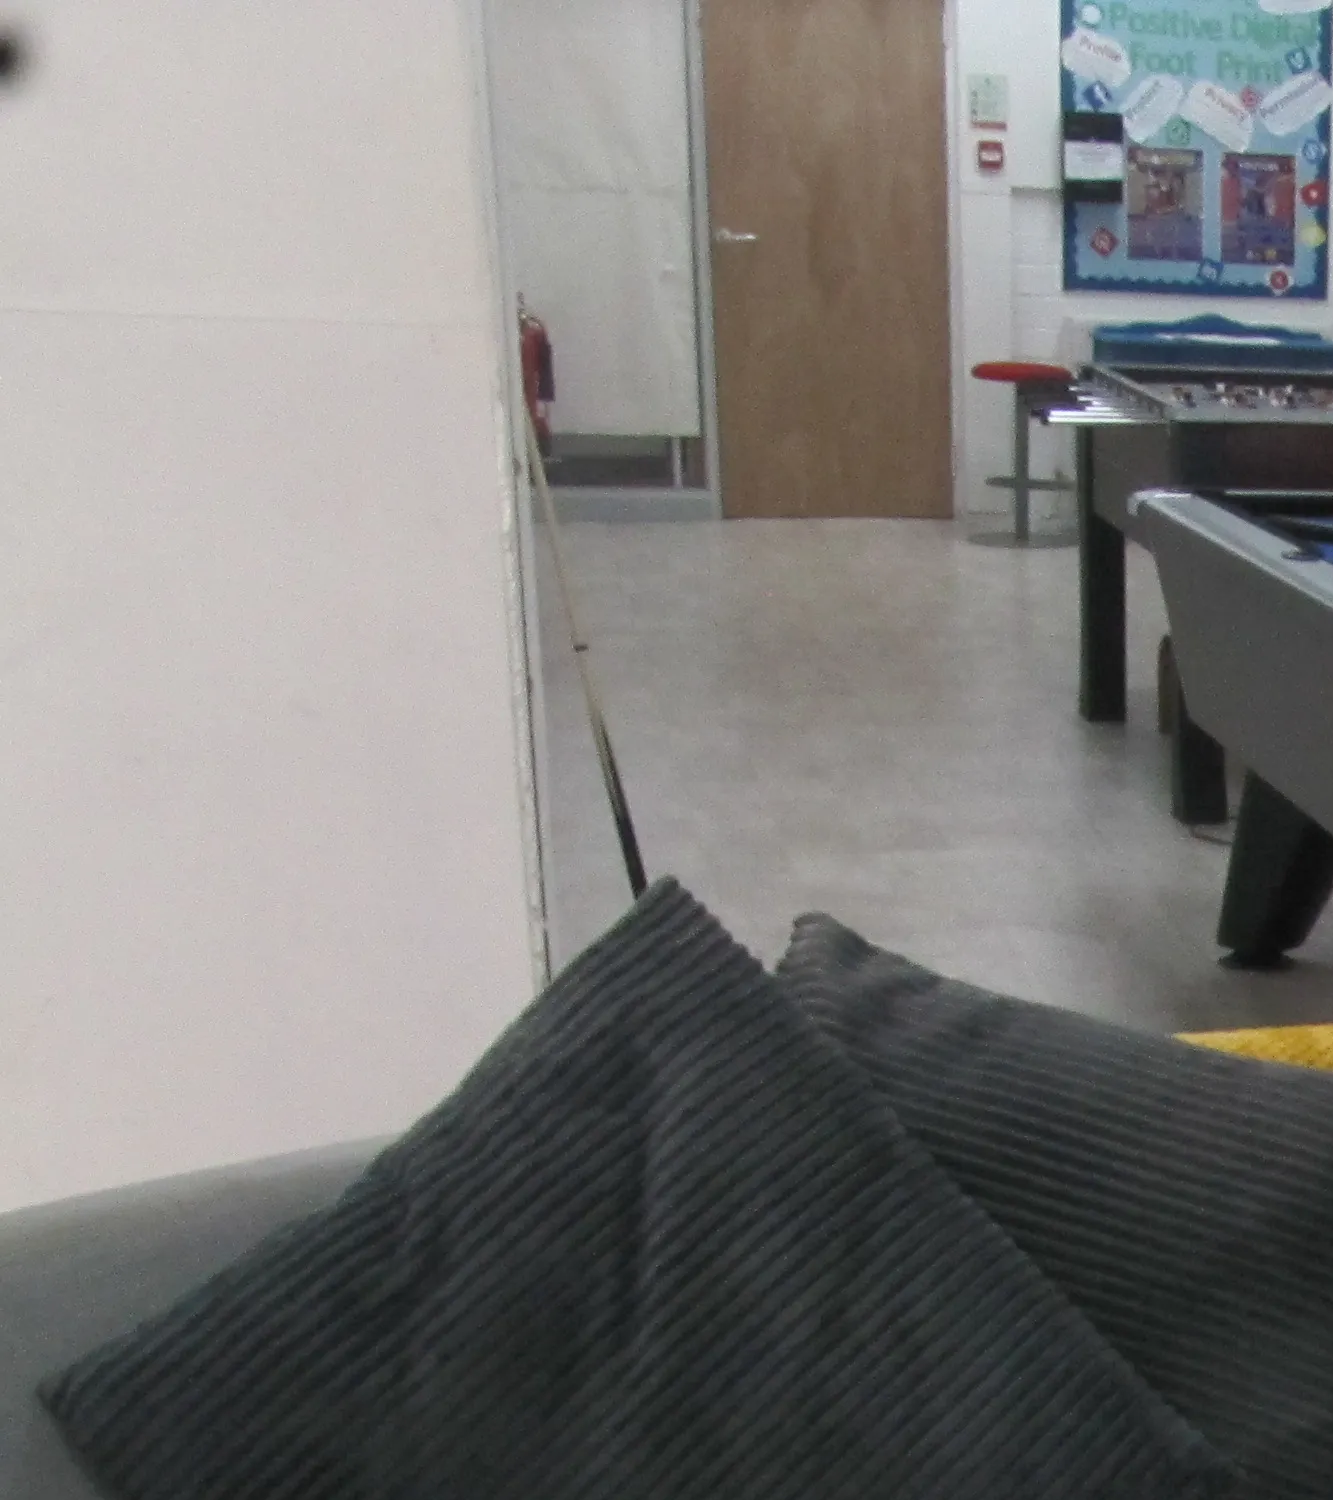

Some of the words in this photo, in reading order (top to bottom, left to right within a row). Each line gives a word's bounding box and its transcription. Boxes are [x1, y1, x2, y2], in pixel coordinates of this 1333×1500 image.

[1108, 2, 1222, 40] Positive
[1130, 40, 1196, 76] Foot
[1217, 49, 1285, 82] Print
